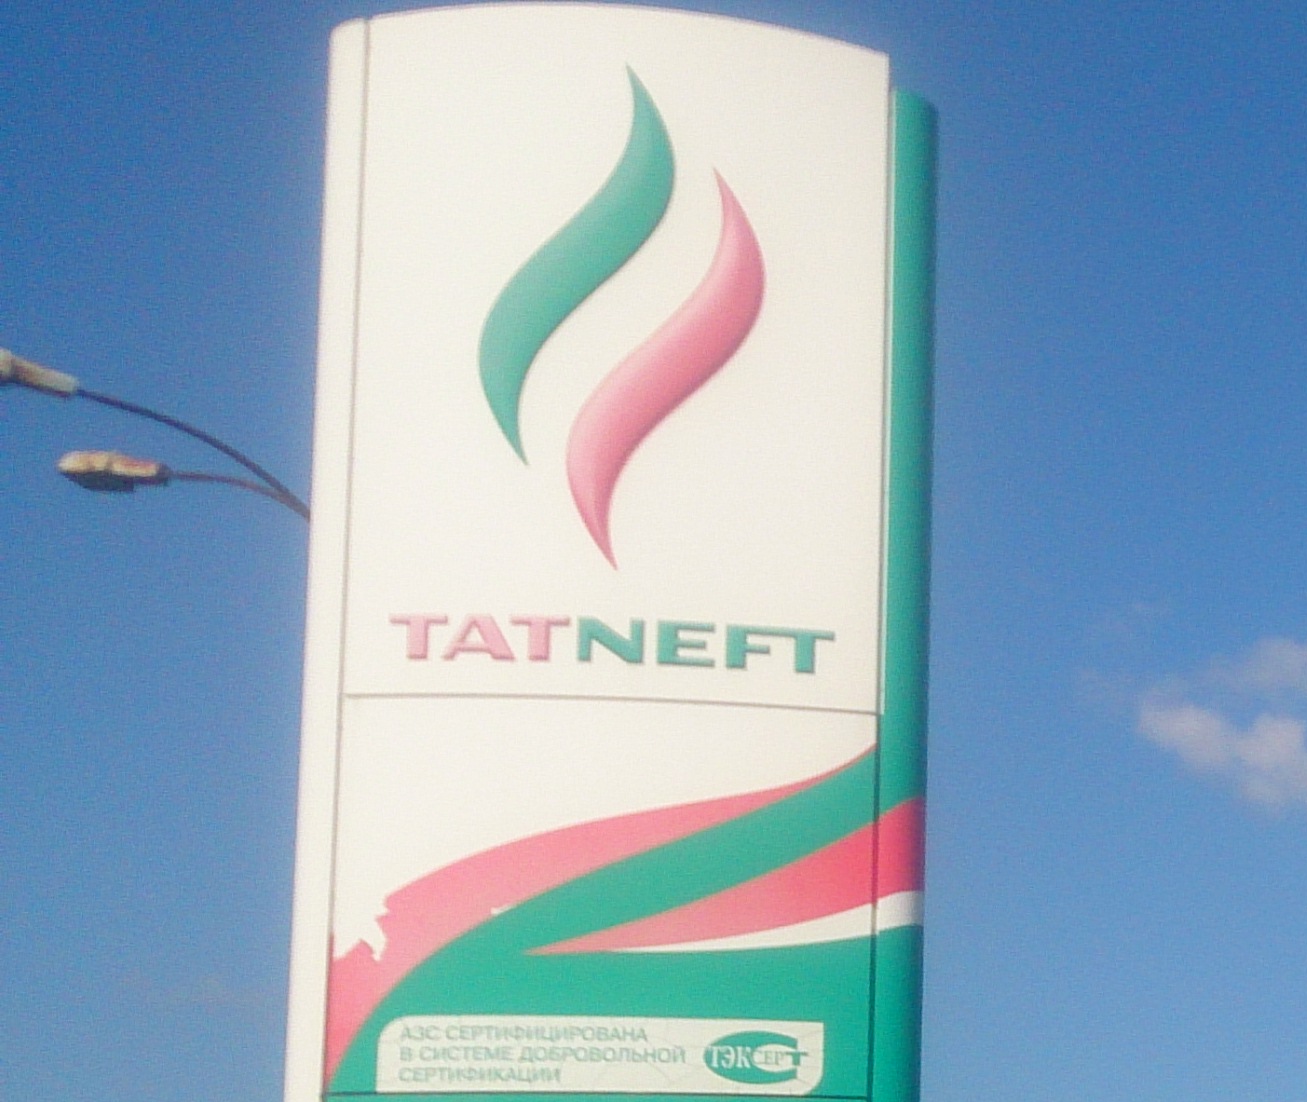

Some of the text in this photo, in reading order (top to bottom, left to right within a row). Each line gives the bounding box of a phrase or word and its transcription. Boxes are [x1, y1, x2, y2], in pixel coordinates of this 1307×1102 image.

[389, 613, 836, 675] TATNEFT
[399, 1024, 648, 1043] АЗС СЕРТИФИЦИРОВАНА
[399, 1045, 687, 1064] В СИСТЕМЕ ДОБРОВОЛЬНОЙ
[398, 1066, 562, 1083] СЕРТИФИКАЦИИ
